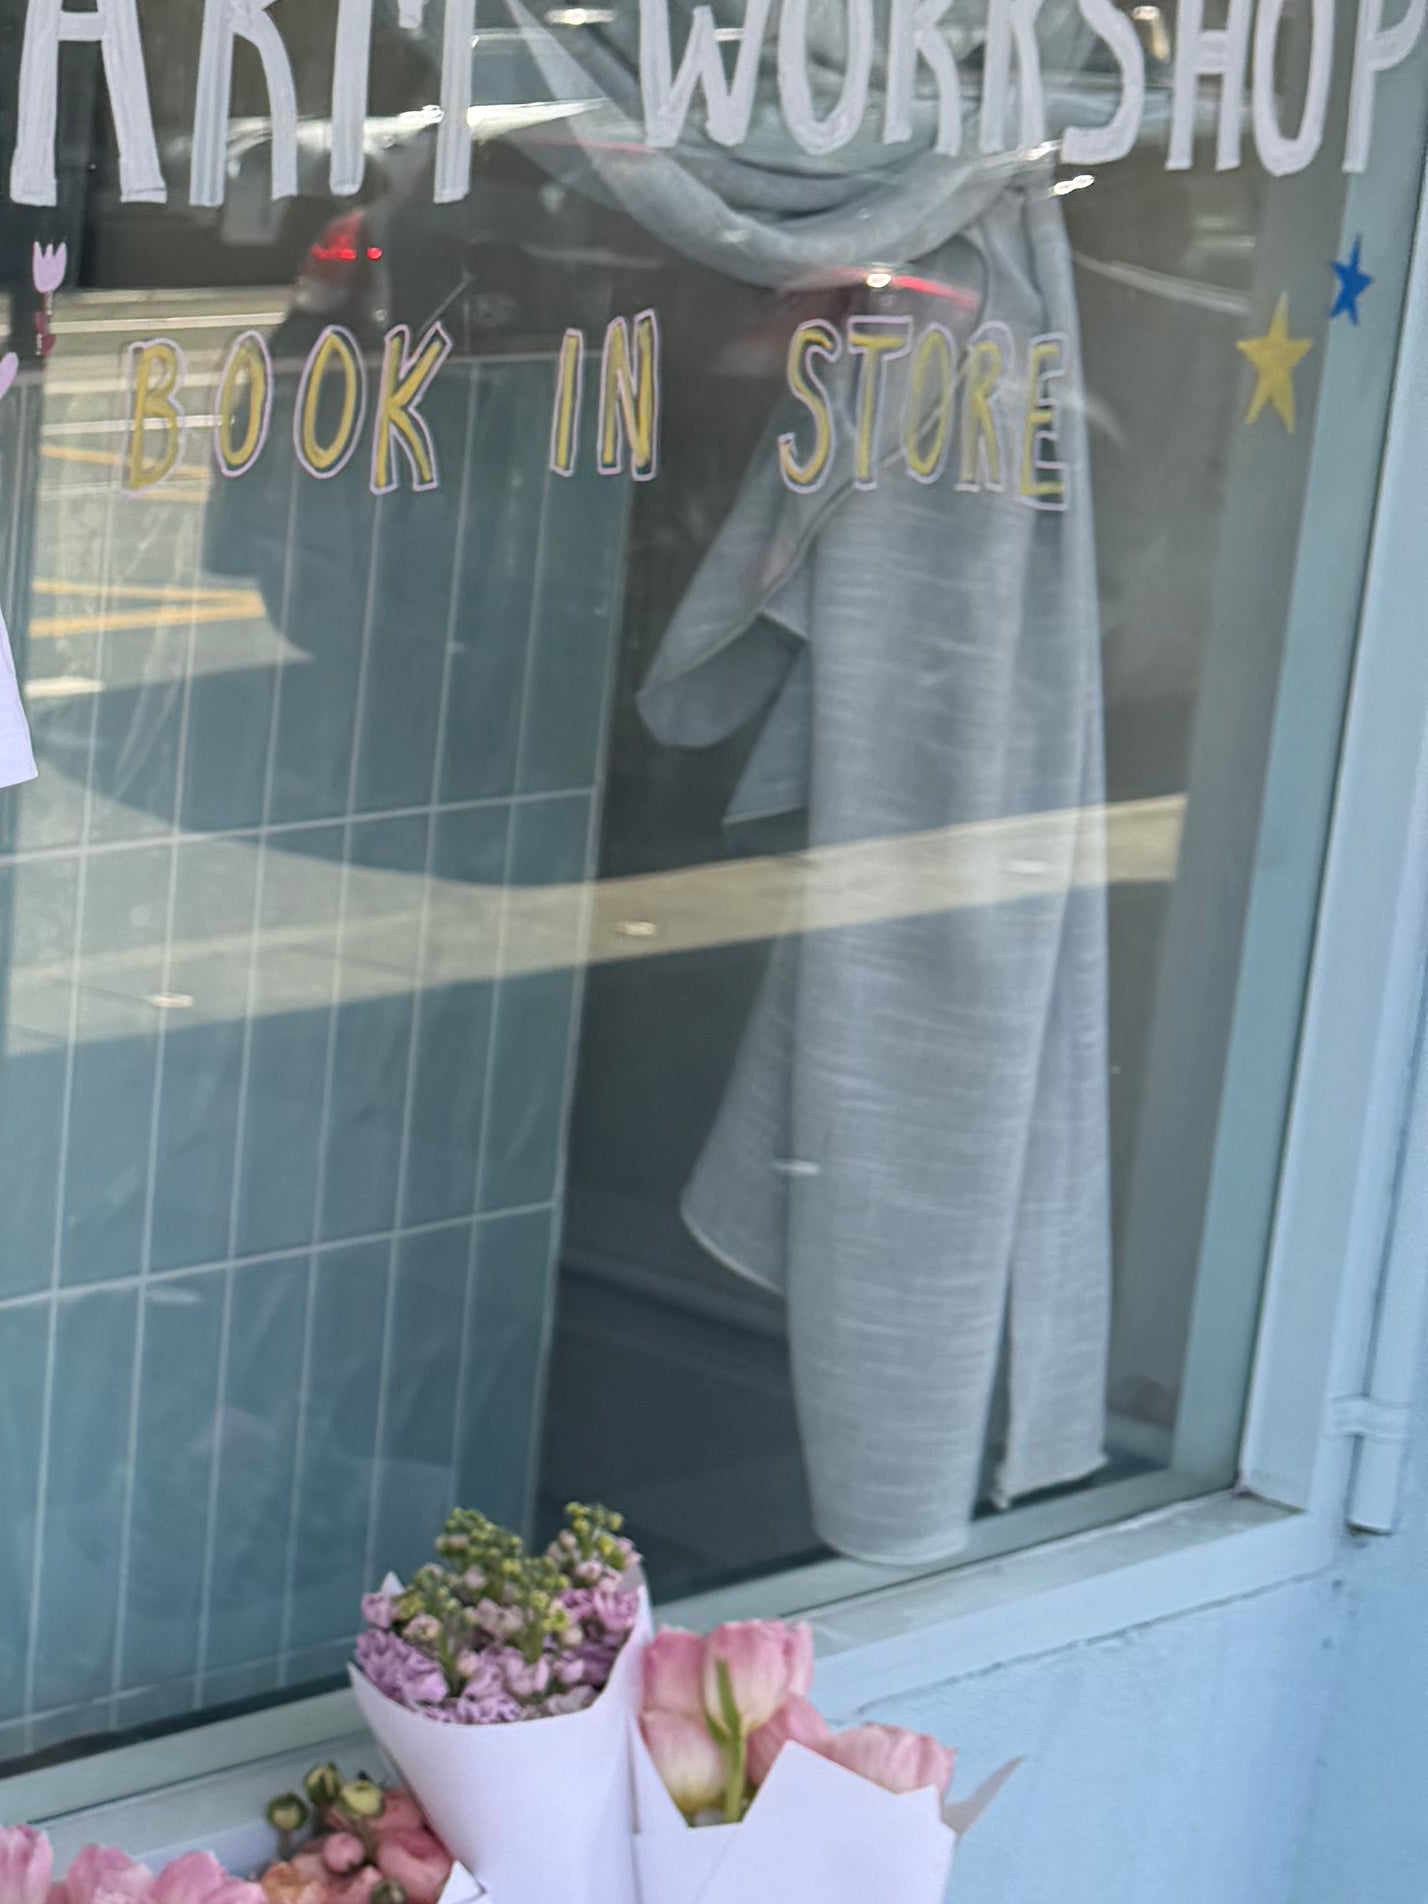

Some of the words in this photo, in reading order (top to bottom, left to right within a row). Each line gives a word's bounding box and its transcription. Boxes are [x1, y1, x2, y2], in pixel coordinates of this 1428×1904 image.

[123, 320, 452, 492] BOOK
[550, 307, 660, 480] IN
[776, 313, 1069, 509] STORE
